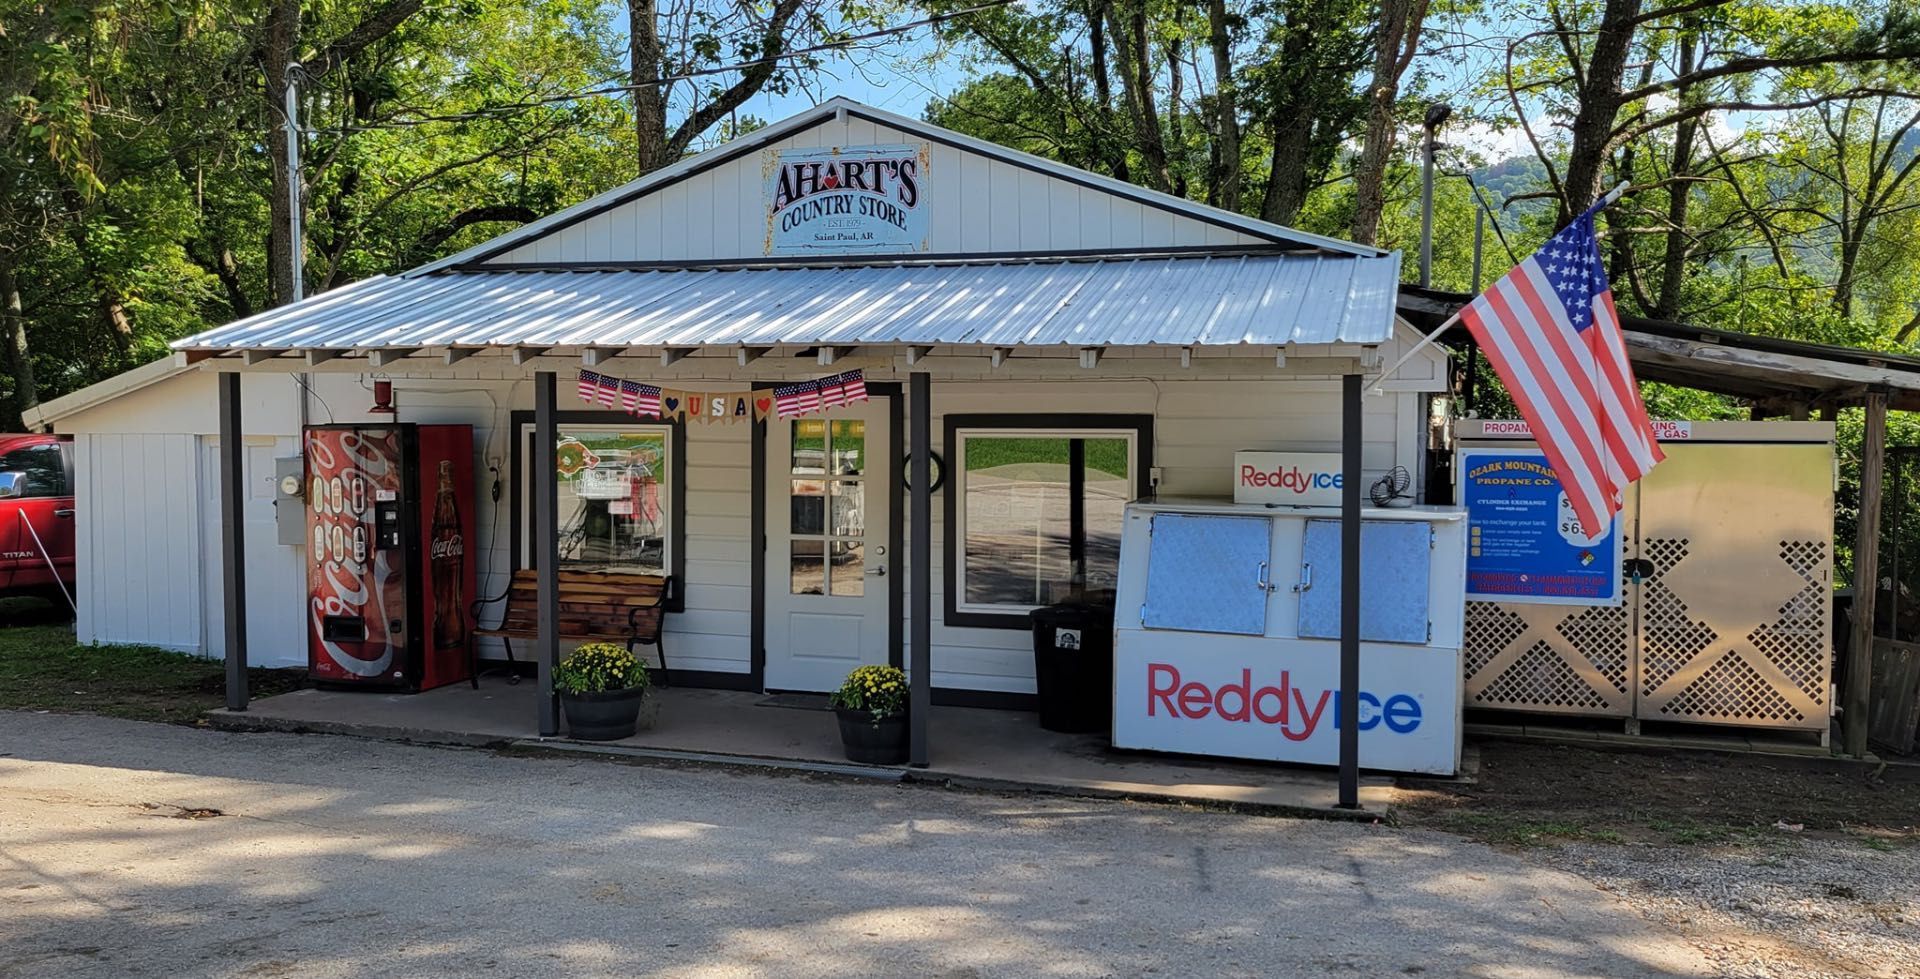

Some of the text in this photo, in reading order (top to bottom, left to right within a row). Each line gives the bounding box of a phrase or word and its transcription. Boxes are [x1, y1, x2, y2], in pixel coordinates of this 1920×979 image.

[772, 157, 919, 214] AHART'S
[782, 195, 908, 232] COUNTRY STORE
[814, 232, 874, 241] Saint Paul, AR
[1484, 423, 1533, 433] PROPAN
[1664, 430, 1689, 438] GAS
[1469, 461, 1557, 479] OZARK MOUNTAIN
[1534, 478, 1554, 486] CO.
